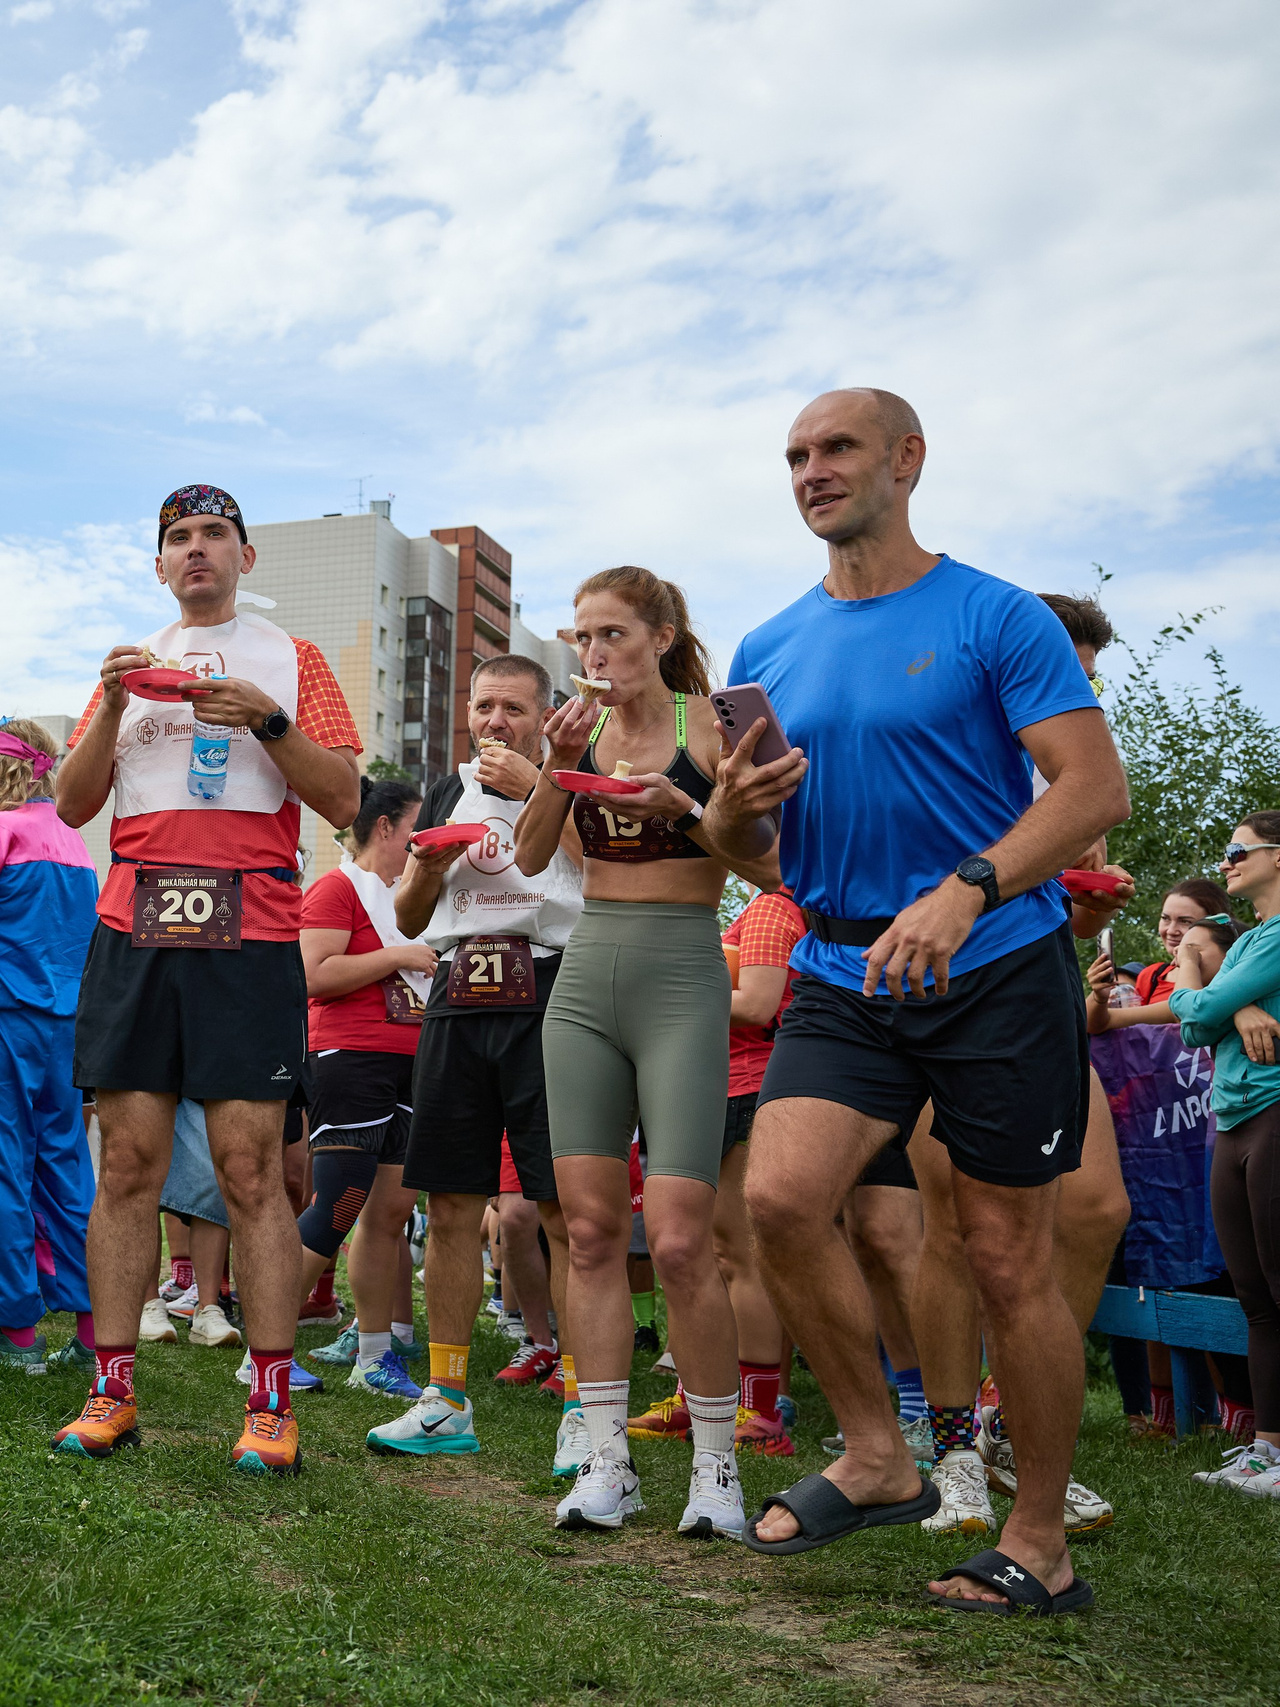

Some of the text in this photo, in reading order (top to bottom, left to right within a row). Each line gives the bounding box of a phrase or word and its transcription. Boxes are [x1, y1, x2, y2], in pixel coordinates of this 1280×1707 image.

[157, 878, 217, 888] ХИНКАЛЬНАЯ МИЛЯ
[159, 889, 214, 924] 20
[468, 953, 503, 983] 21
